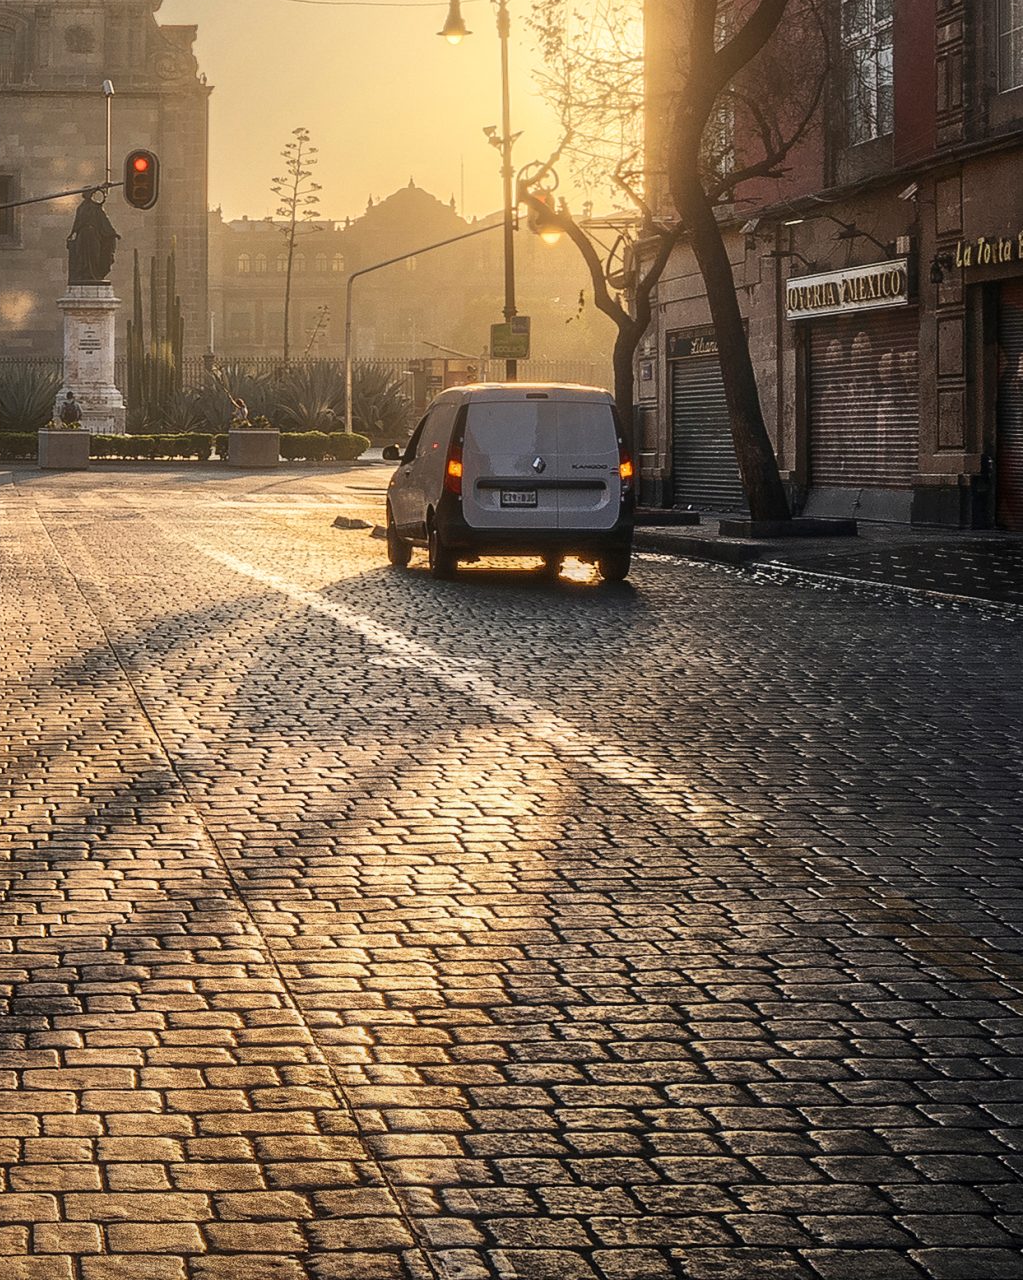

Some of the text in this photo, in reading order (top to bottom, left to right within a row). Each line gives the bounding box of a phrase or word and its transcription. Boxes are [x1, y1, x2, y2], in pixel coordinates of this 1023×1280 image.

[956, 240, 971, 267] La
[785, 282, 836, 310] JOYERIA
[844, 271, 901, 301] MEXICO
